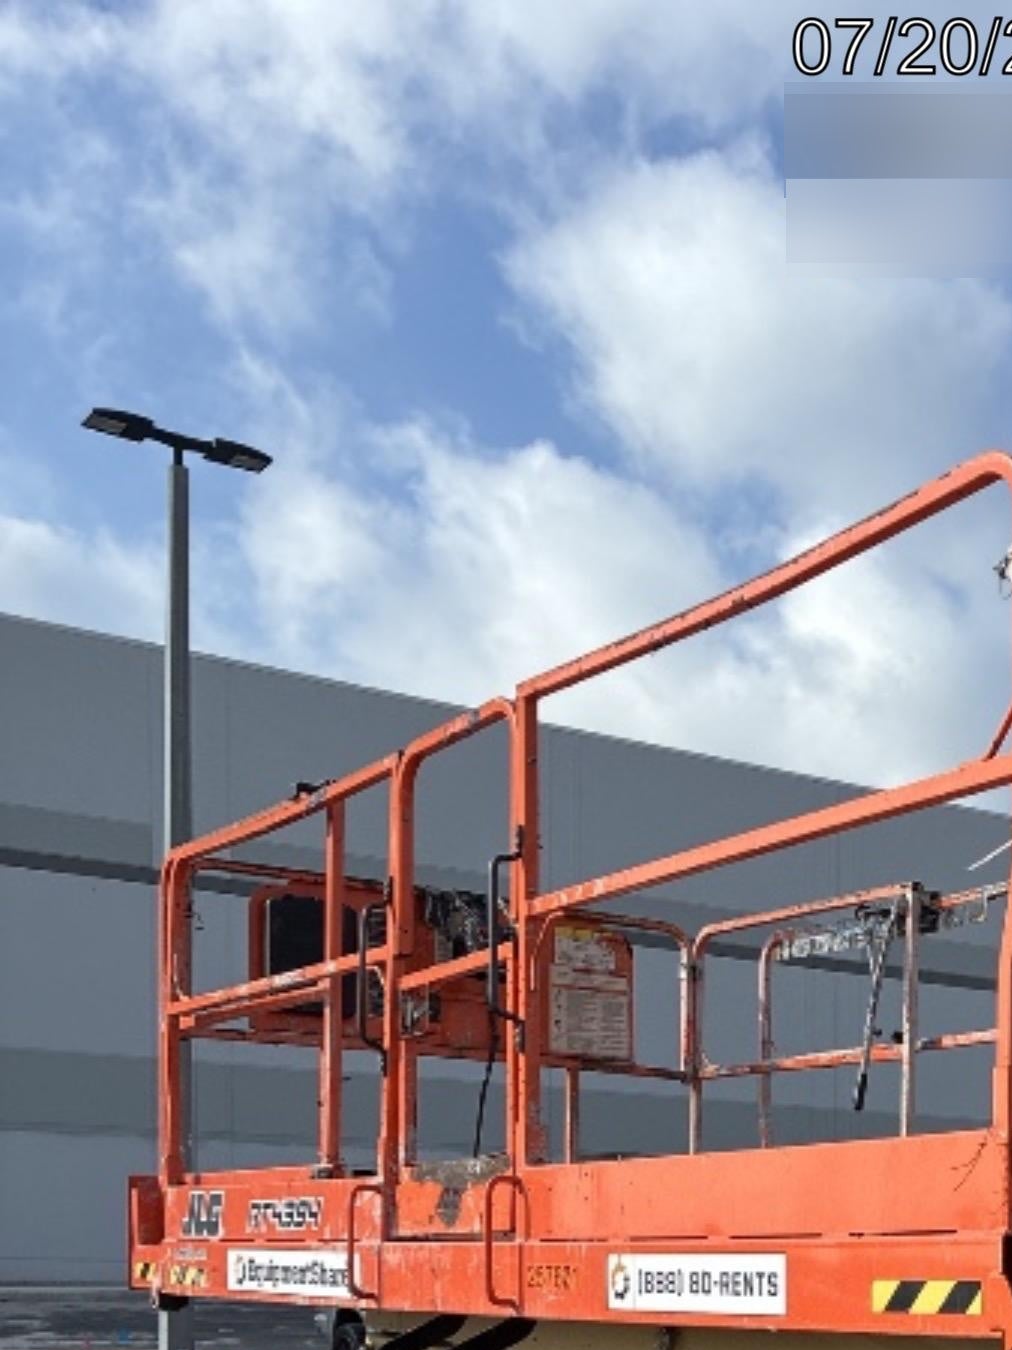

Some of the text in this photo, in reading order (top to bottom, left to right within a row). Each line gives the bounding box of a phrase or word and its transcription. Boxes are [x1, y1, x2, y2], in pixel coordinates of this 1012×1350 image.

[182, 1191, 224, 1238] JLG
[247, 1257, 349, 1288] EquipmentShare
[638, 1268, 779, 1297] (888) 80-RENTS
